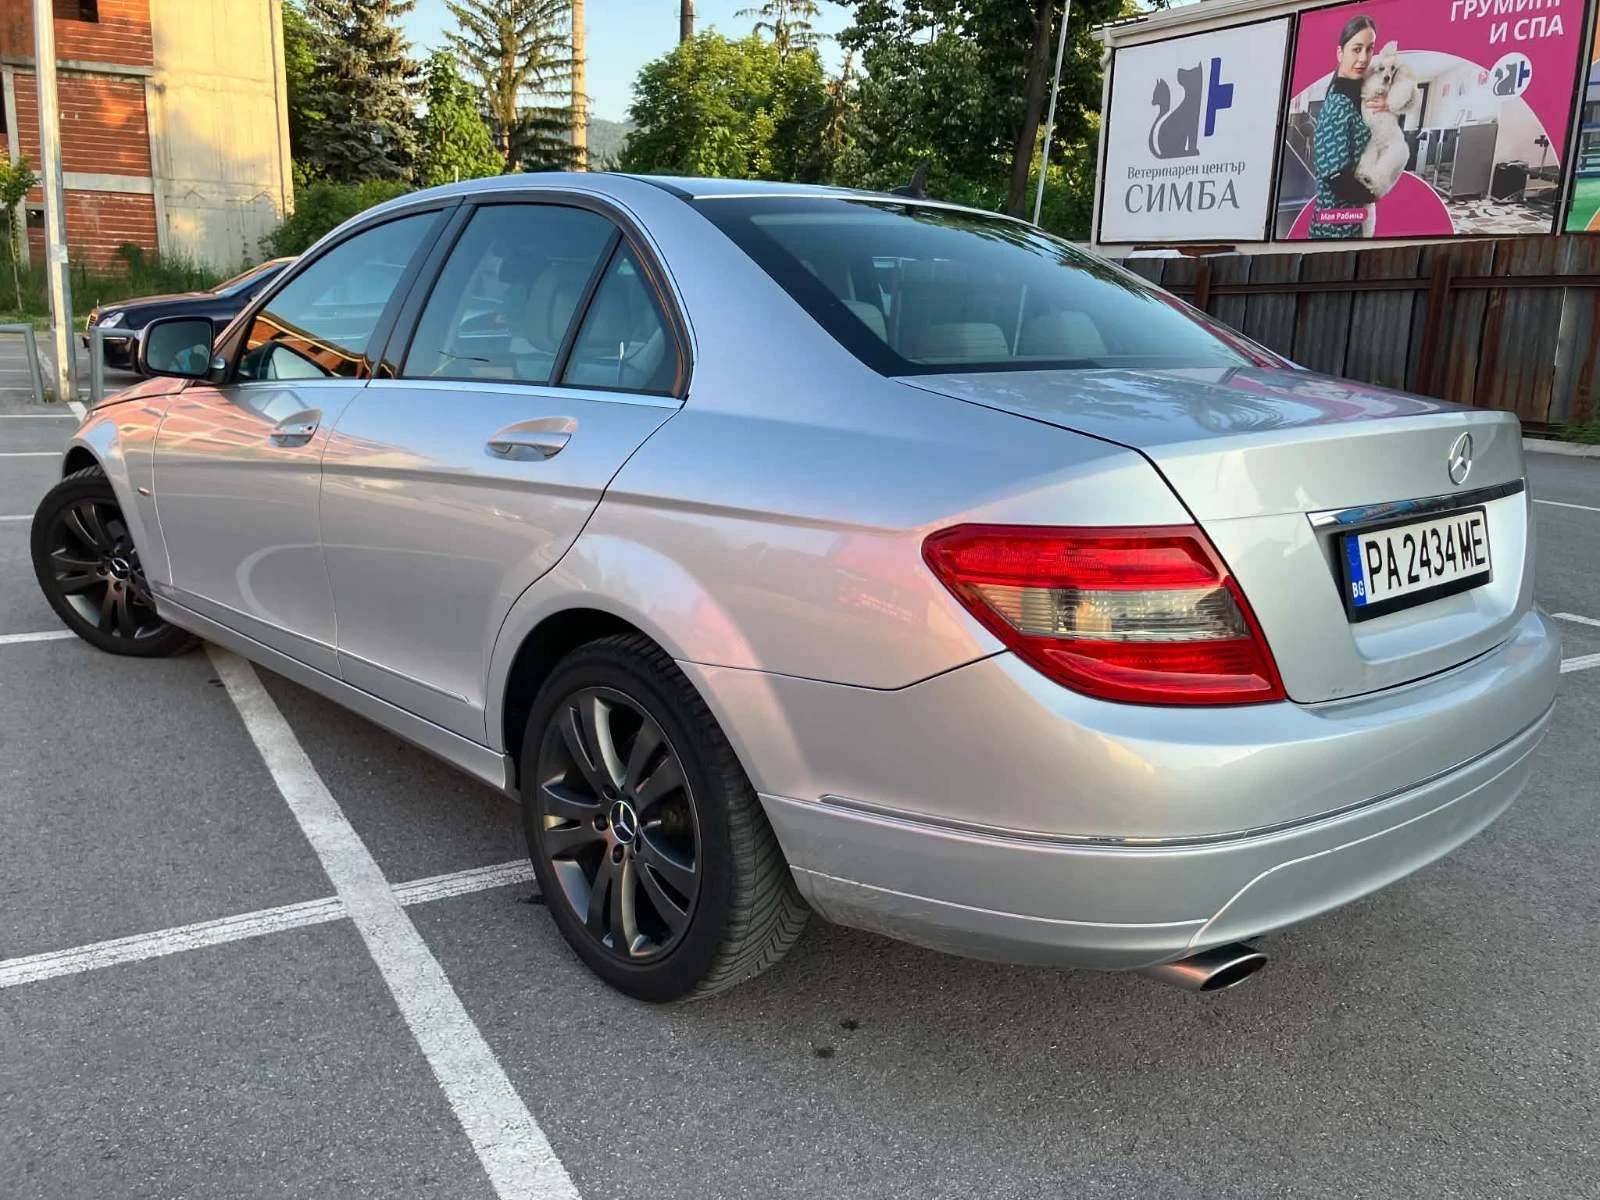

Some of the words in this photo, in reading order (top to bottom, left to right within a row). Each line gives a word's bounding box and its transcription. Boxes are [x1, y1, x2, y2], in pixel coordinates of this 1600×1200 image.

[1450, 0, 1560, 21] ГРУМИ
[1489, 22, 1508, 44] И
[1513, 15, 1564, 40] СПА
[1127, 164, 1199, 180] Ветеринарен
[1202, 161, 1246, 176] център
[1125, 179, 1240, 213] СИМБА
[1352, 581, 1365, 598] BG
